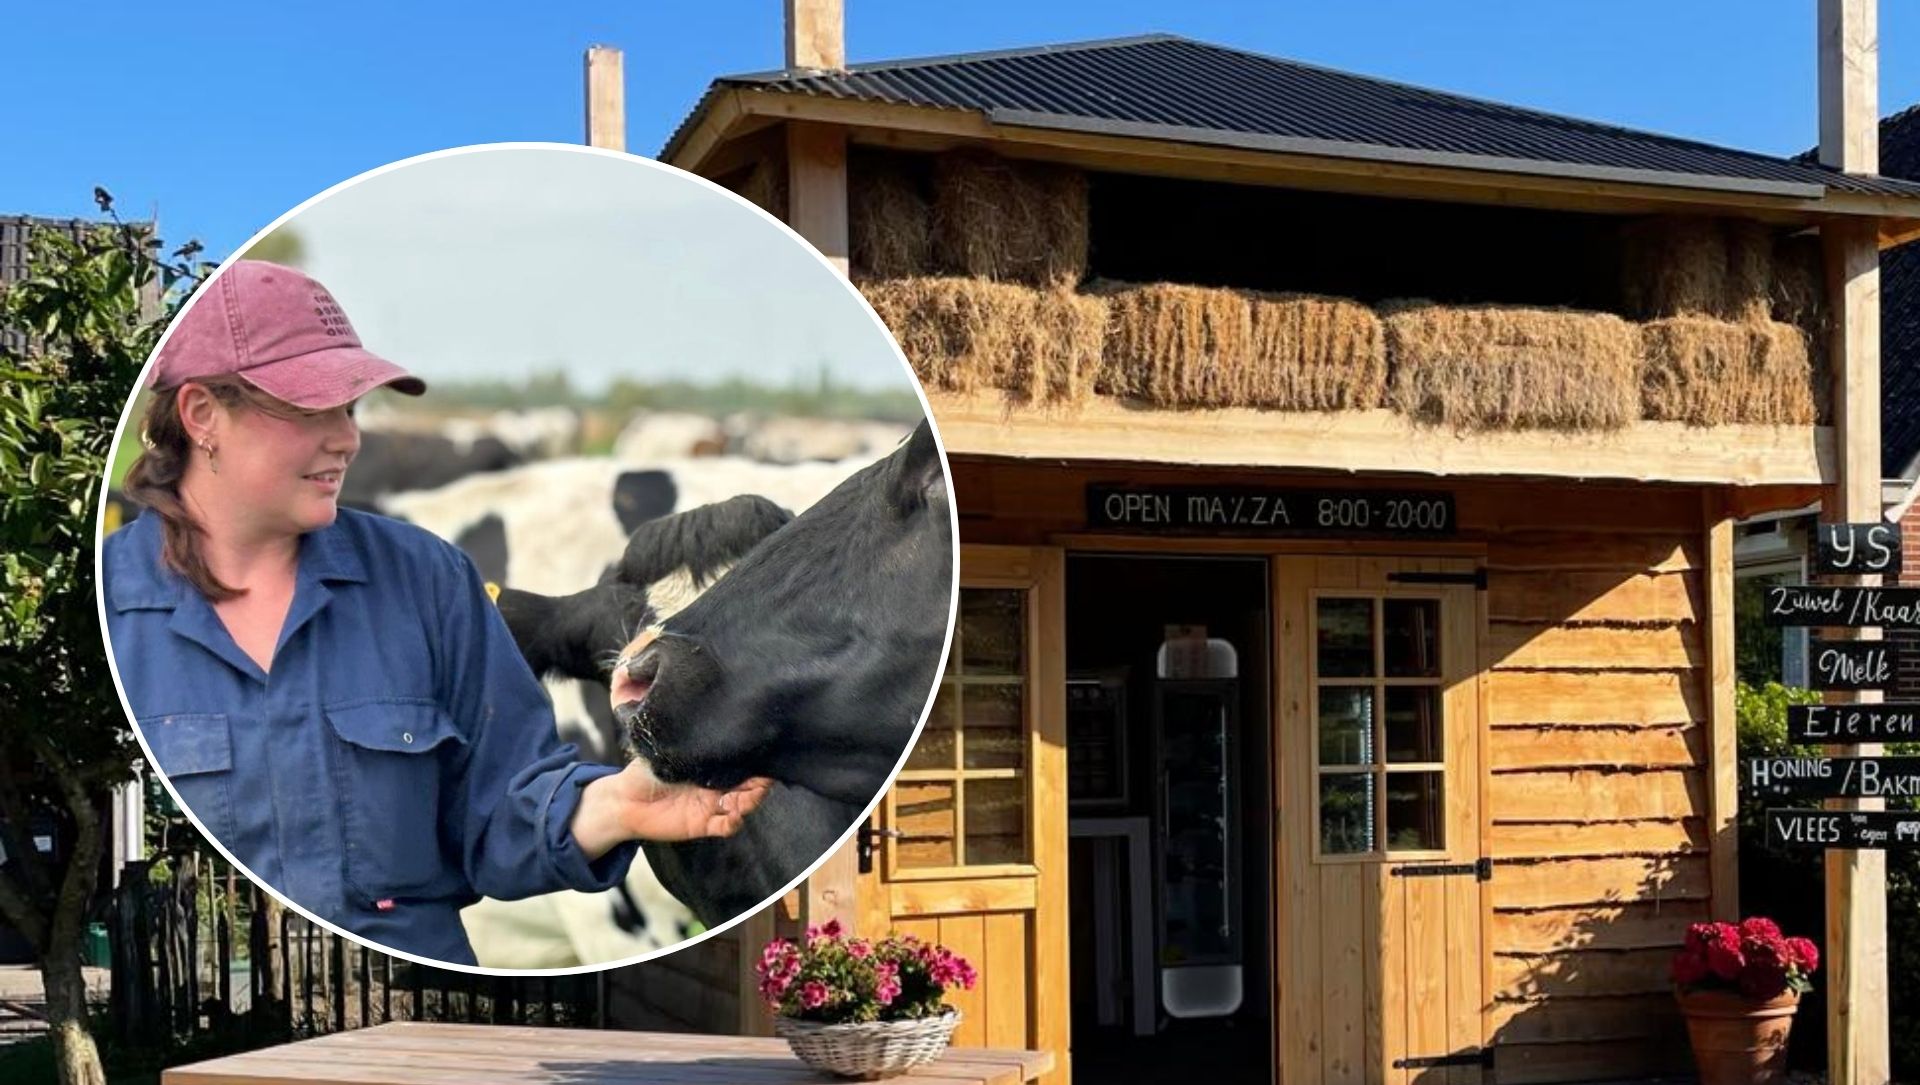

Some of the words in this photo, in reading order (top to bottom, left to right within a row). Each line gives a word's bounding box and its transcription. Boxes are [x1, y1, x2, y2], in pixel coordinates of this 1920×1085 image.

[1104, 494, 1171, 523] OPEN
[1819, 649, 1891, 684] Melk
[1803, 706, 1914, 736] Eieren
[1774, 816, 1841, 843] VLEES
